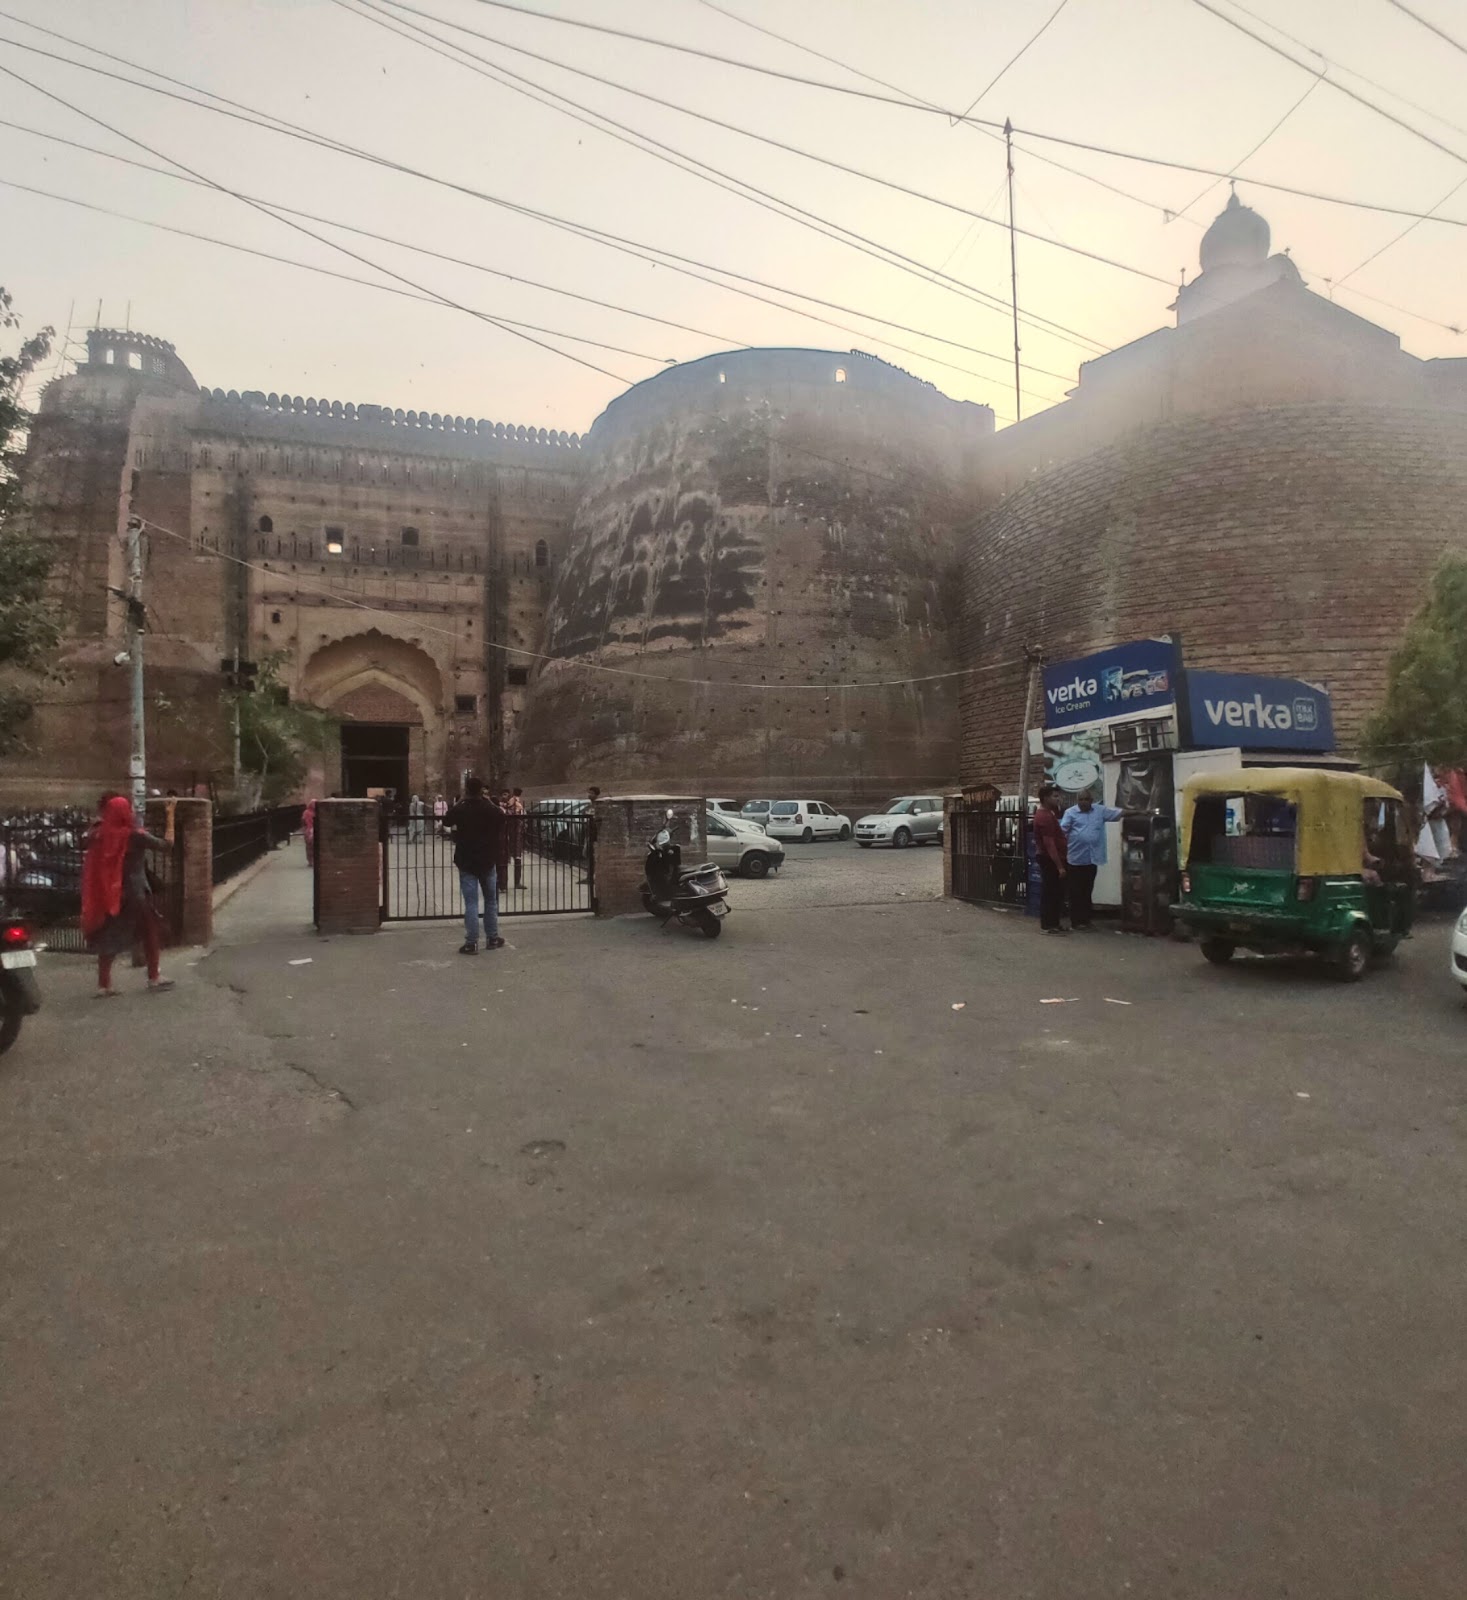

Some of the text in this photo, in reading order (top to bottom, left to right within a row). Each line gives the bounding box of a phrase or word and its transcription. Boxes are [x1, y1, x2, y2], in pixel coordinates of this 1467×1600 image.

[1047, 676, 1098, 705] verka
[1055, 700, 1091, 714] Ice Cream
[1204, 693, 1292, 729] verka
